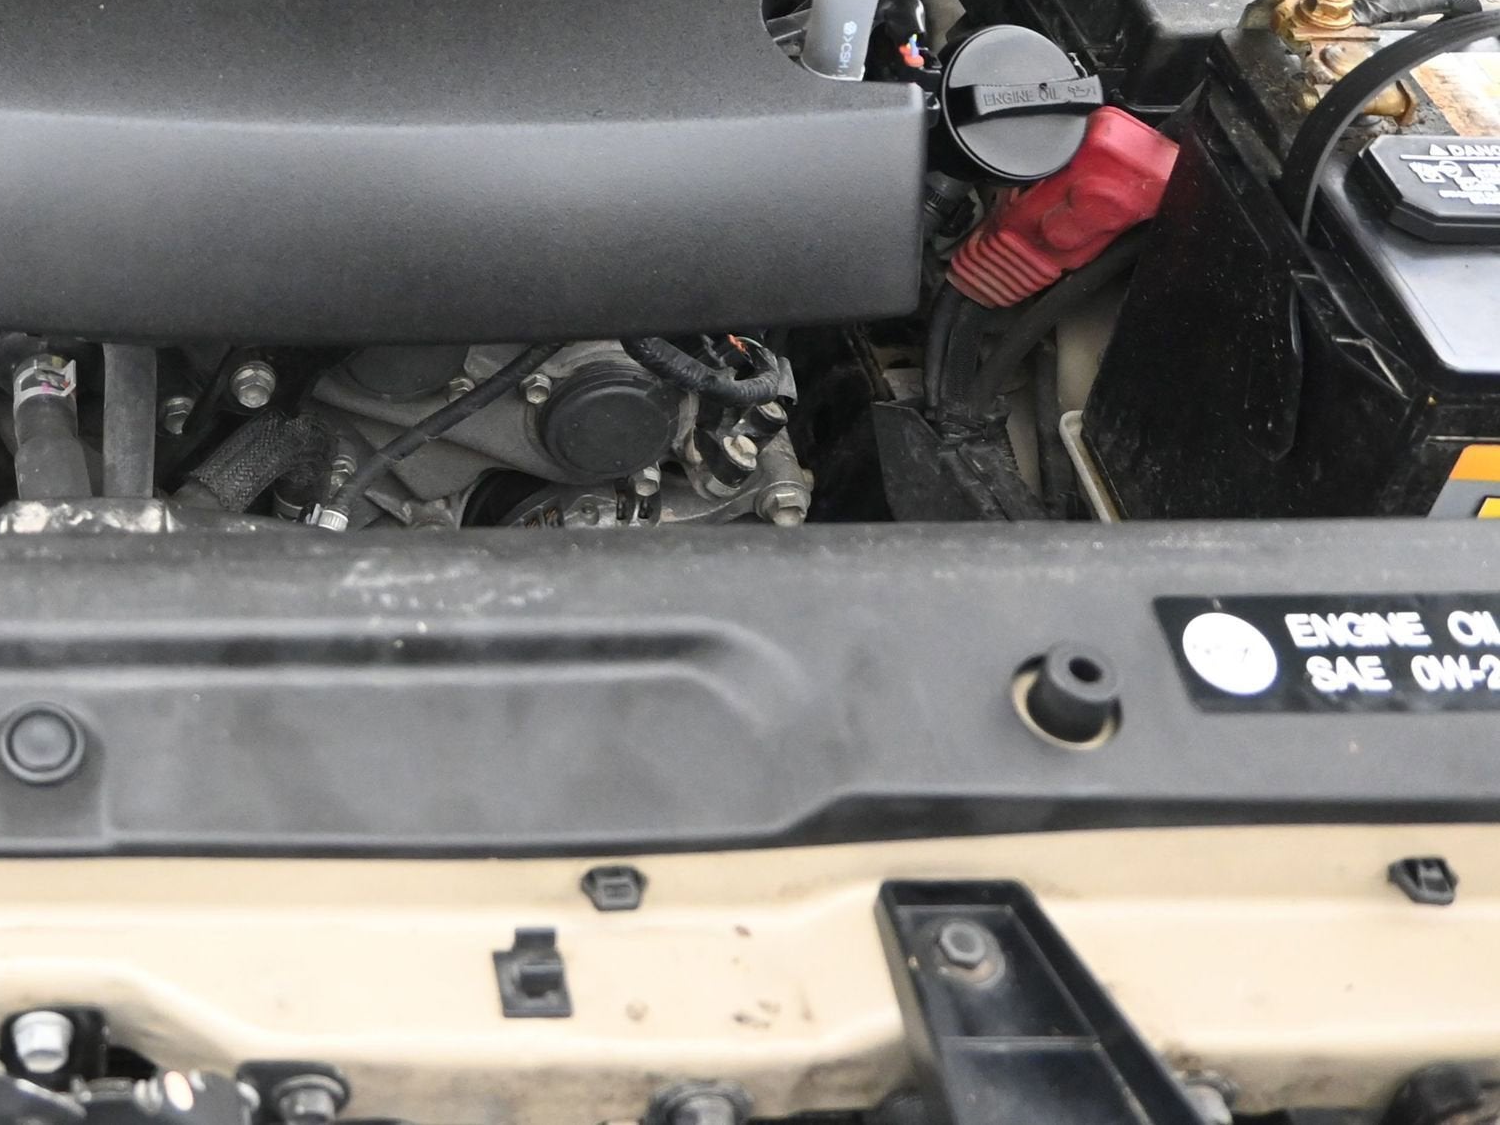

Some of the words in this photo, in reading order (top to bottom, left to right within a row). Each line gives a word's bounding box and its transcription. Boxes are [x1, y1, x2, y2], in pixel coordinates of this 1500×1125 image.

[983, 90, 1036, 107] ENGINE
[1038, 86, 1061, 103] OIL
[1284, 612, 1433, 648] ENGINE
[1306, 655, 1393, 694] SAE
